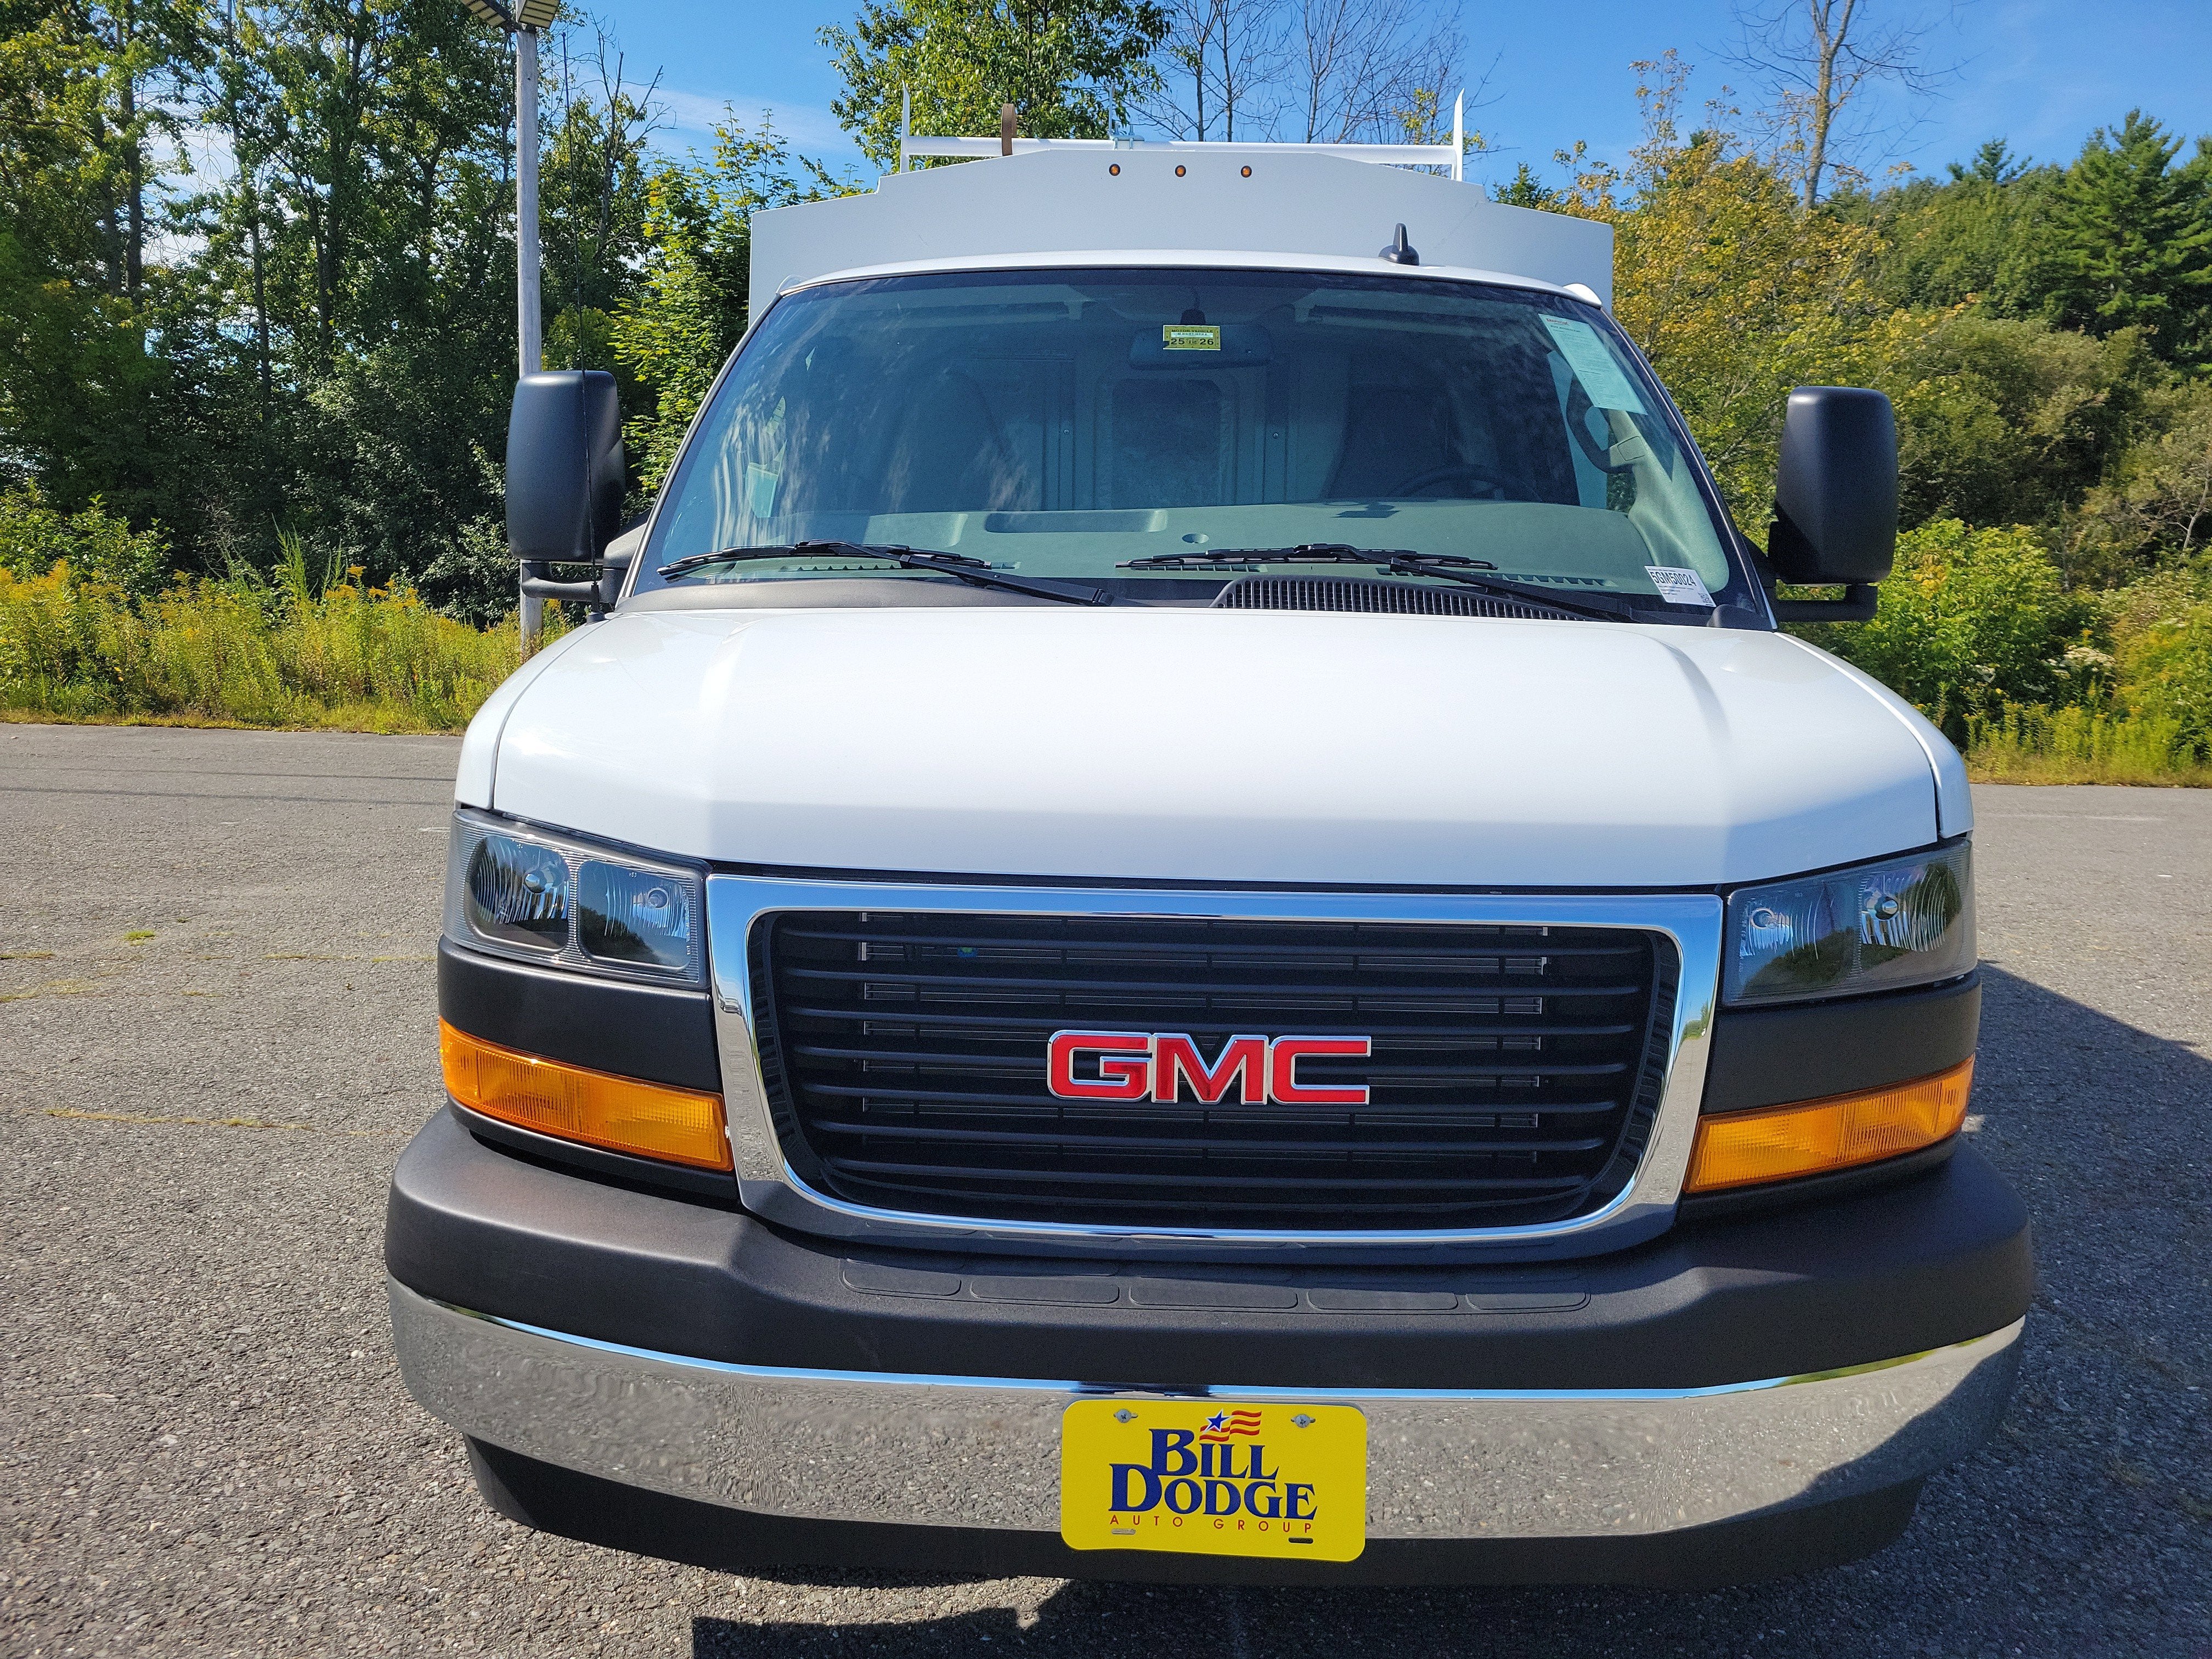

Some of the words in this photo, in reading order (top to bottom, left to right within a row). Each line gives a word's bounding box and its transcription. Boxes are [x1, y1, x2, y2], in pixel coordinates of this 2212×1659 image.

[1650, 572, 1696, 586] 5GM50024
[1047, 1030, 1372, 1105] GMC
[1149, 1428, 1279, 1480] BILL
[1108, 1463, 1318, 1521] DODGE
[1109, 1514, 1183, 1528] AUTO
[1213, 1518, 1313, 1534] GROUP
